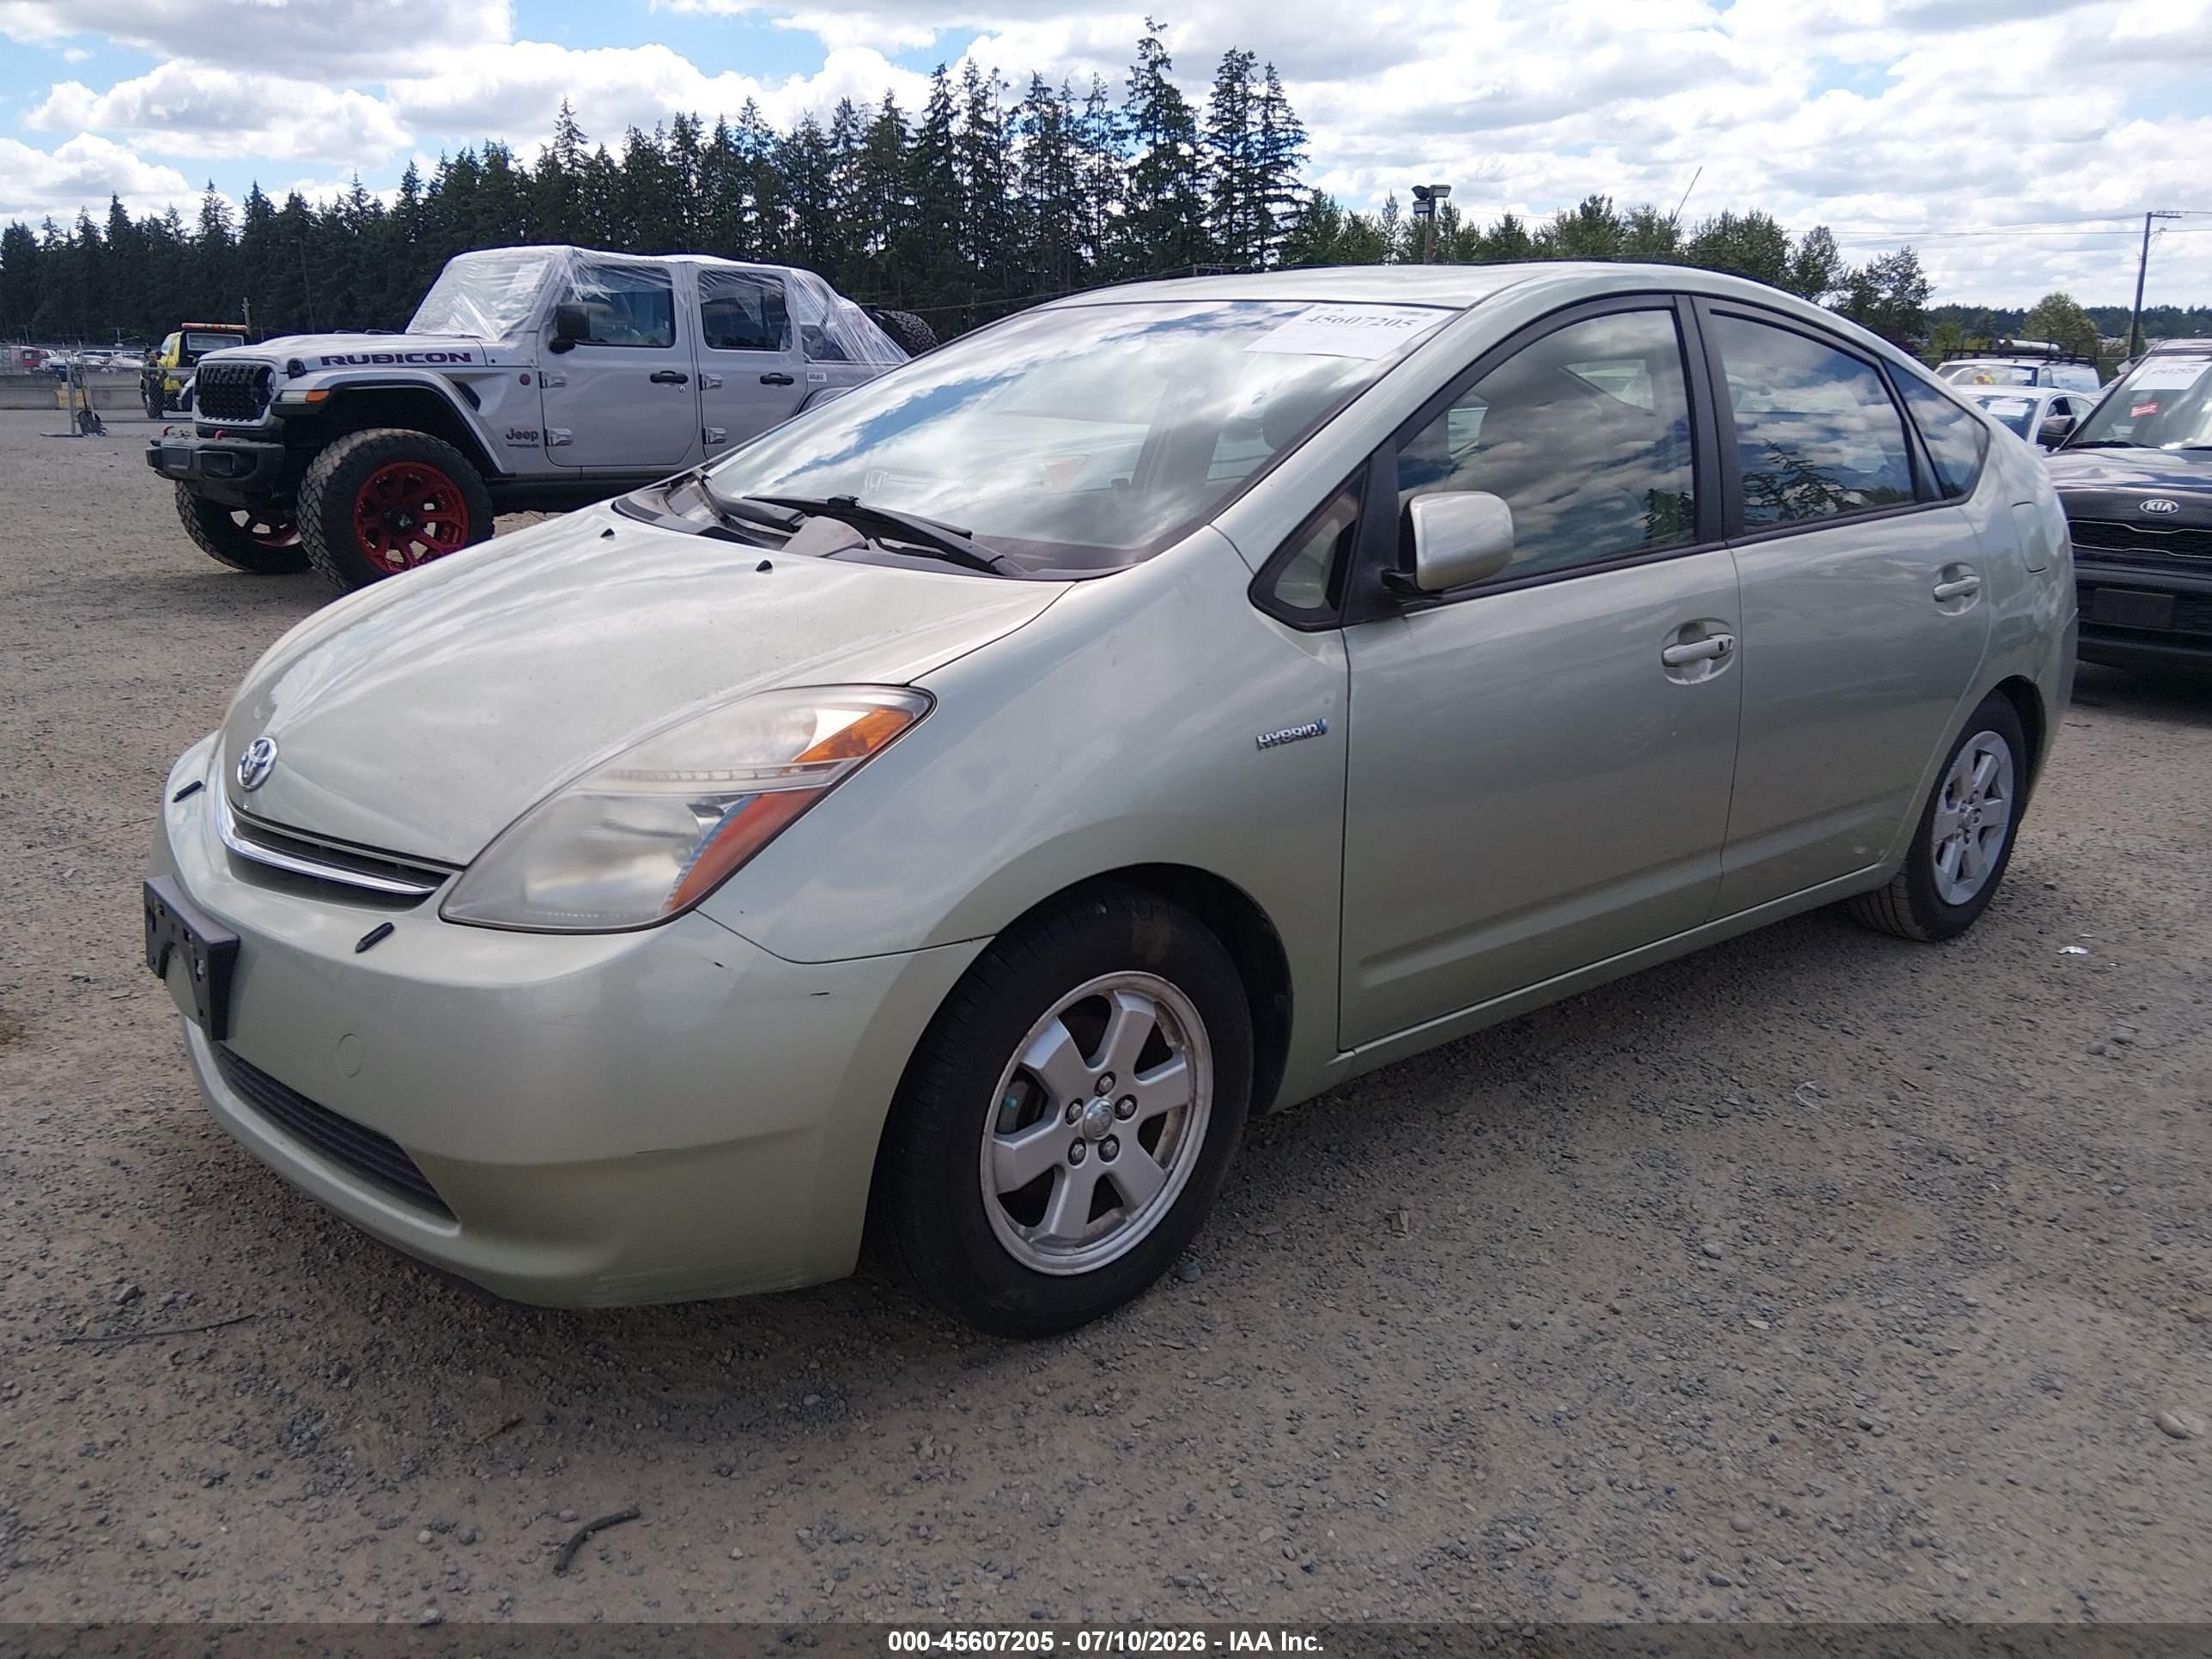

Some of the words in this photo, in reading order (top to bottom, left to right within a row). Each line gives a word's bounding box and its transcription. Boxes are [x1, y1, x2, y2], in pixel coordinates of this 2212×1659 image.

[1307, 314, 1419, 329] 45607205
[320, 352, 471, 366] RUBICON
[506, 428, 538, 441] Jeep
[2146, 501, 2172, 512] KIA
[1256, 722, 1320, 750] HYBRID
